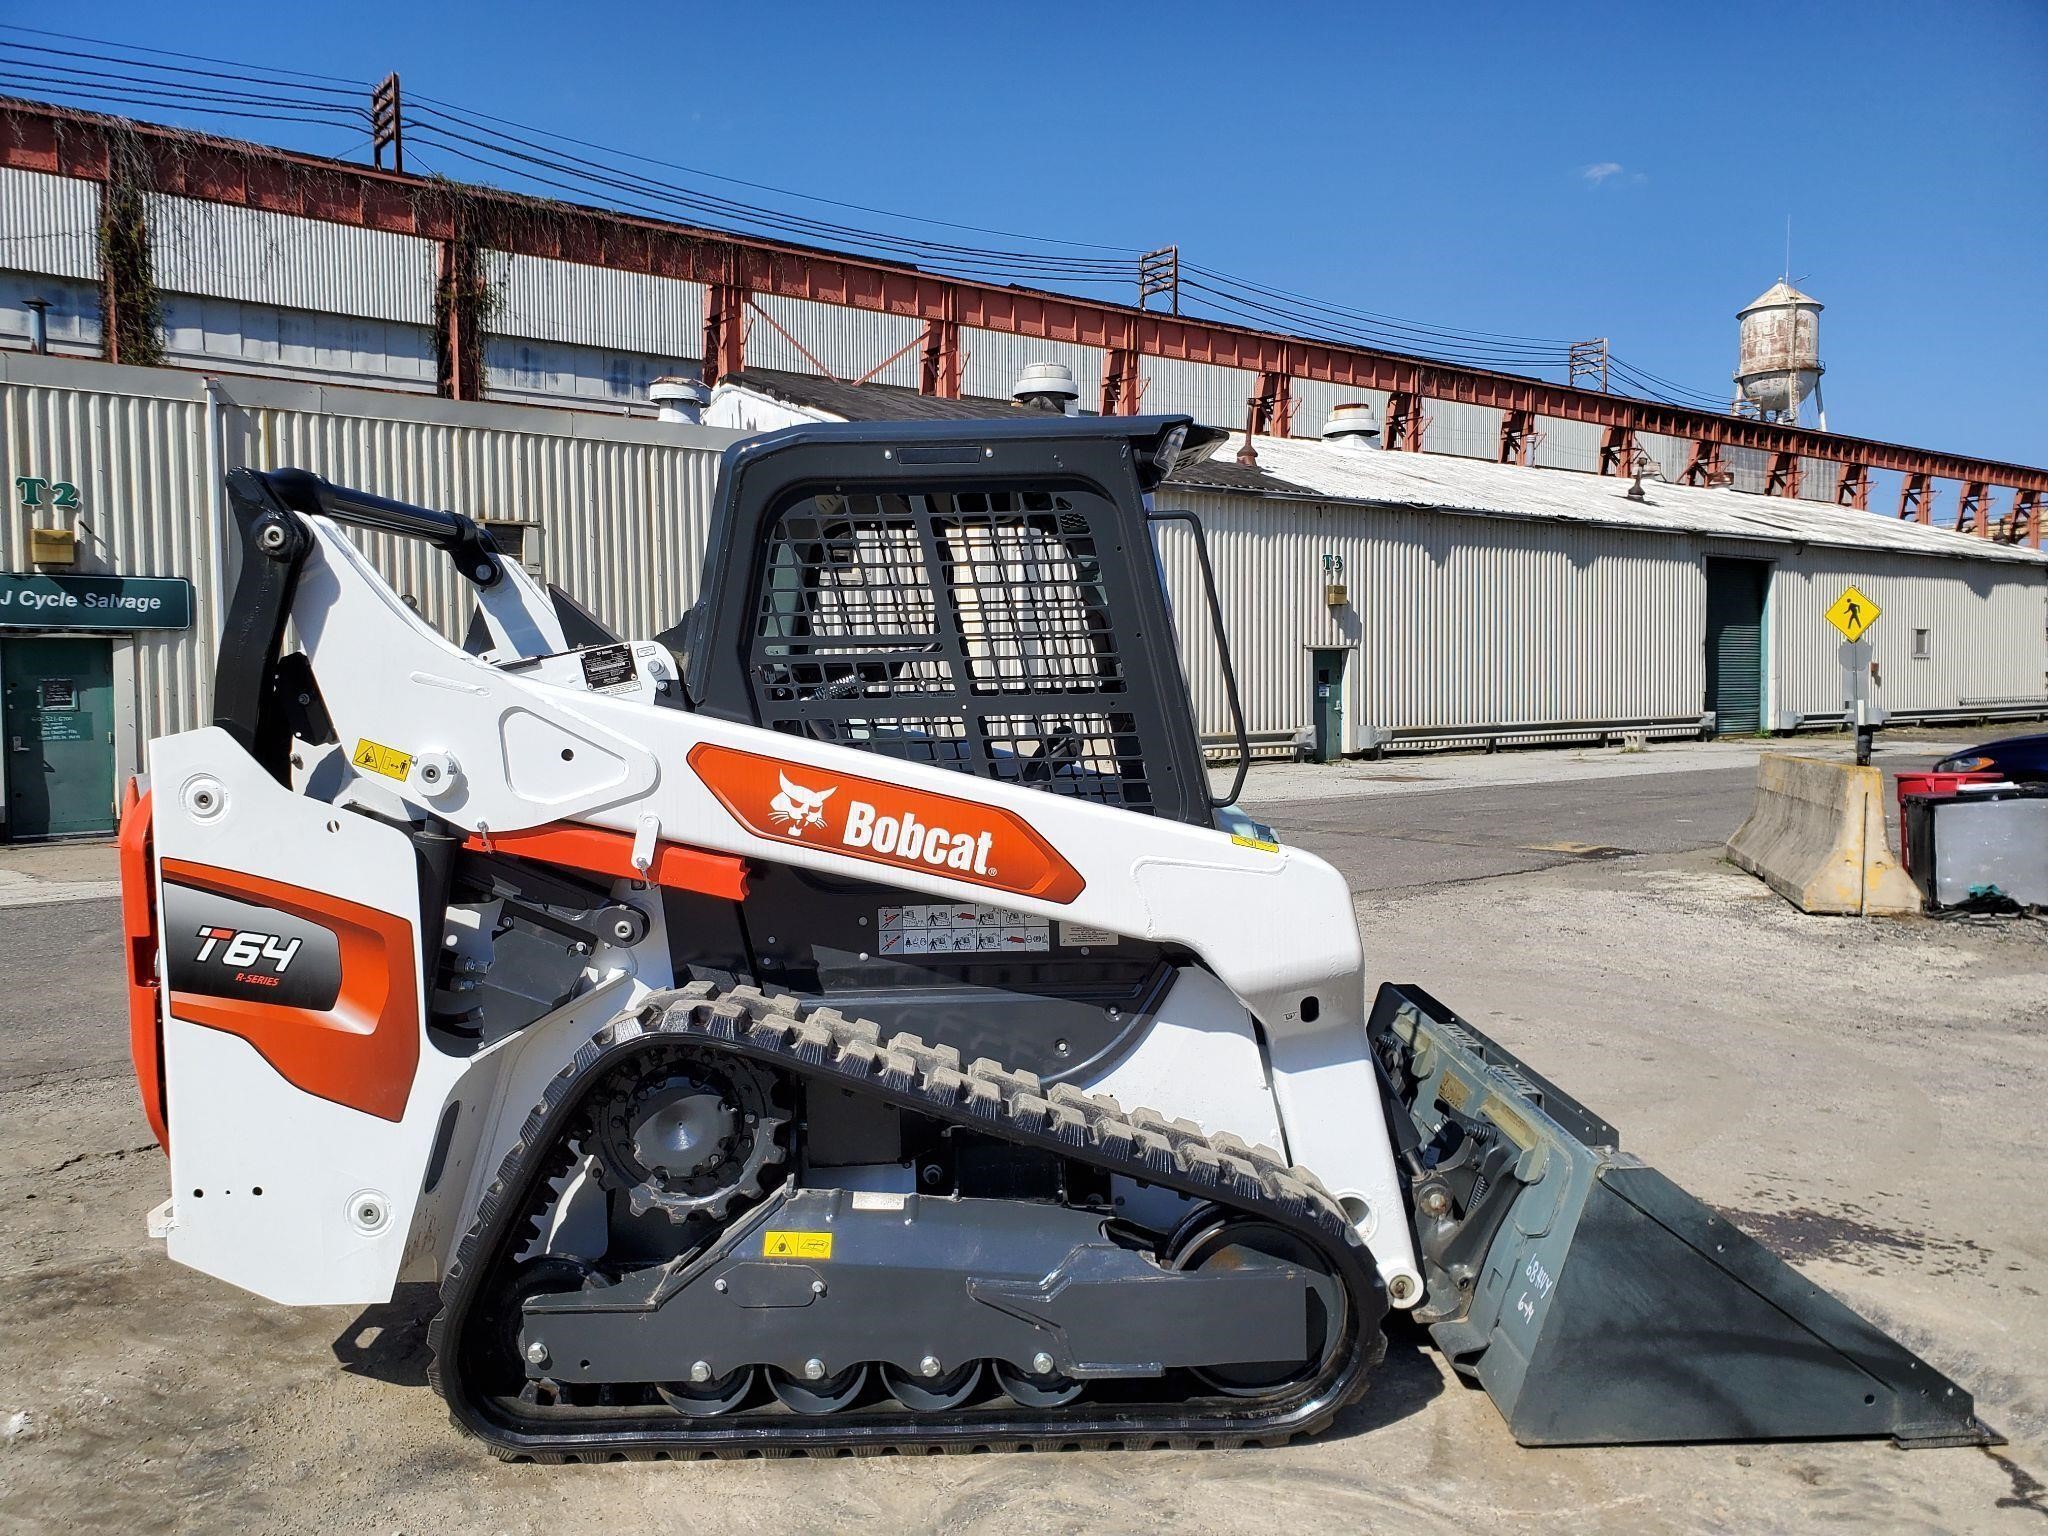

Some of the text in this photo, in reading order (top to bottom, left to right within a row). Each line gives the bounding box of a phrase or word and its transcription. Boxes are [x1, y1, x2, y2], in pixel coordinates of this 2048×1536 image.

[19, 590, 78, 610] Cycle
[84, 592, 161, 613] Salvage
[843, 800, 993, 875] Bobcat
[196, 926, 302, 973] T64
[235, 972, 280, 986] R-SERIES
